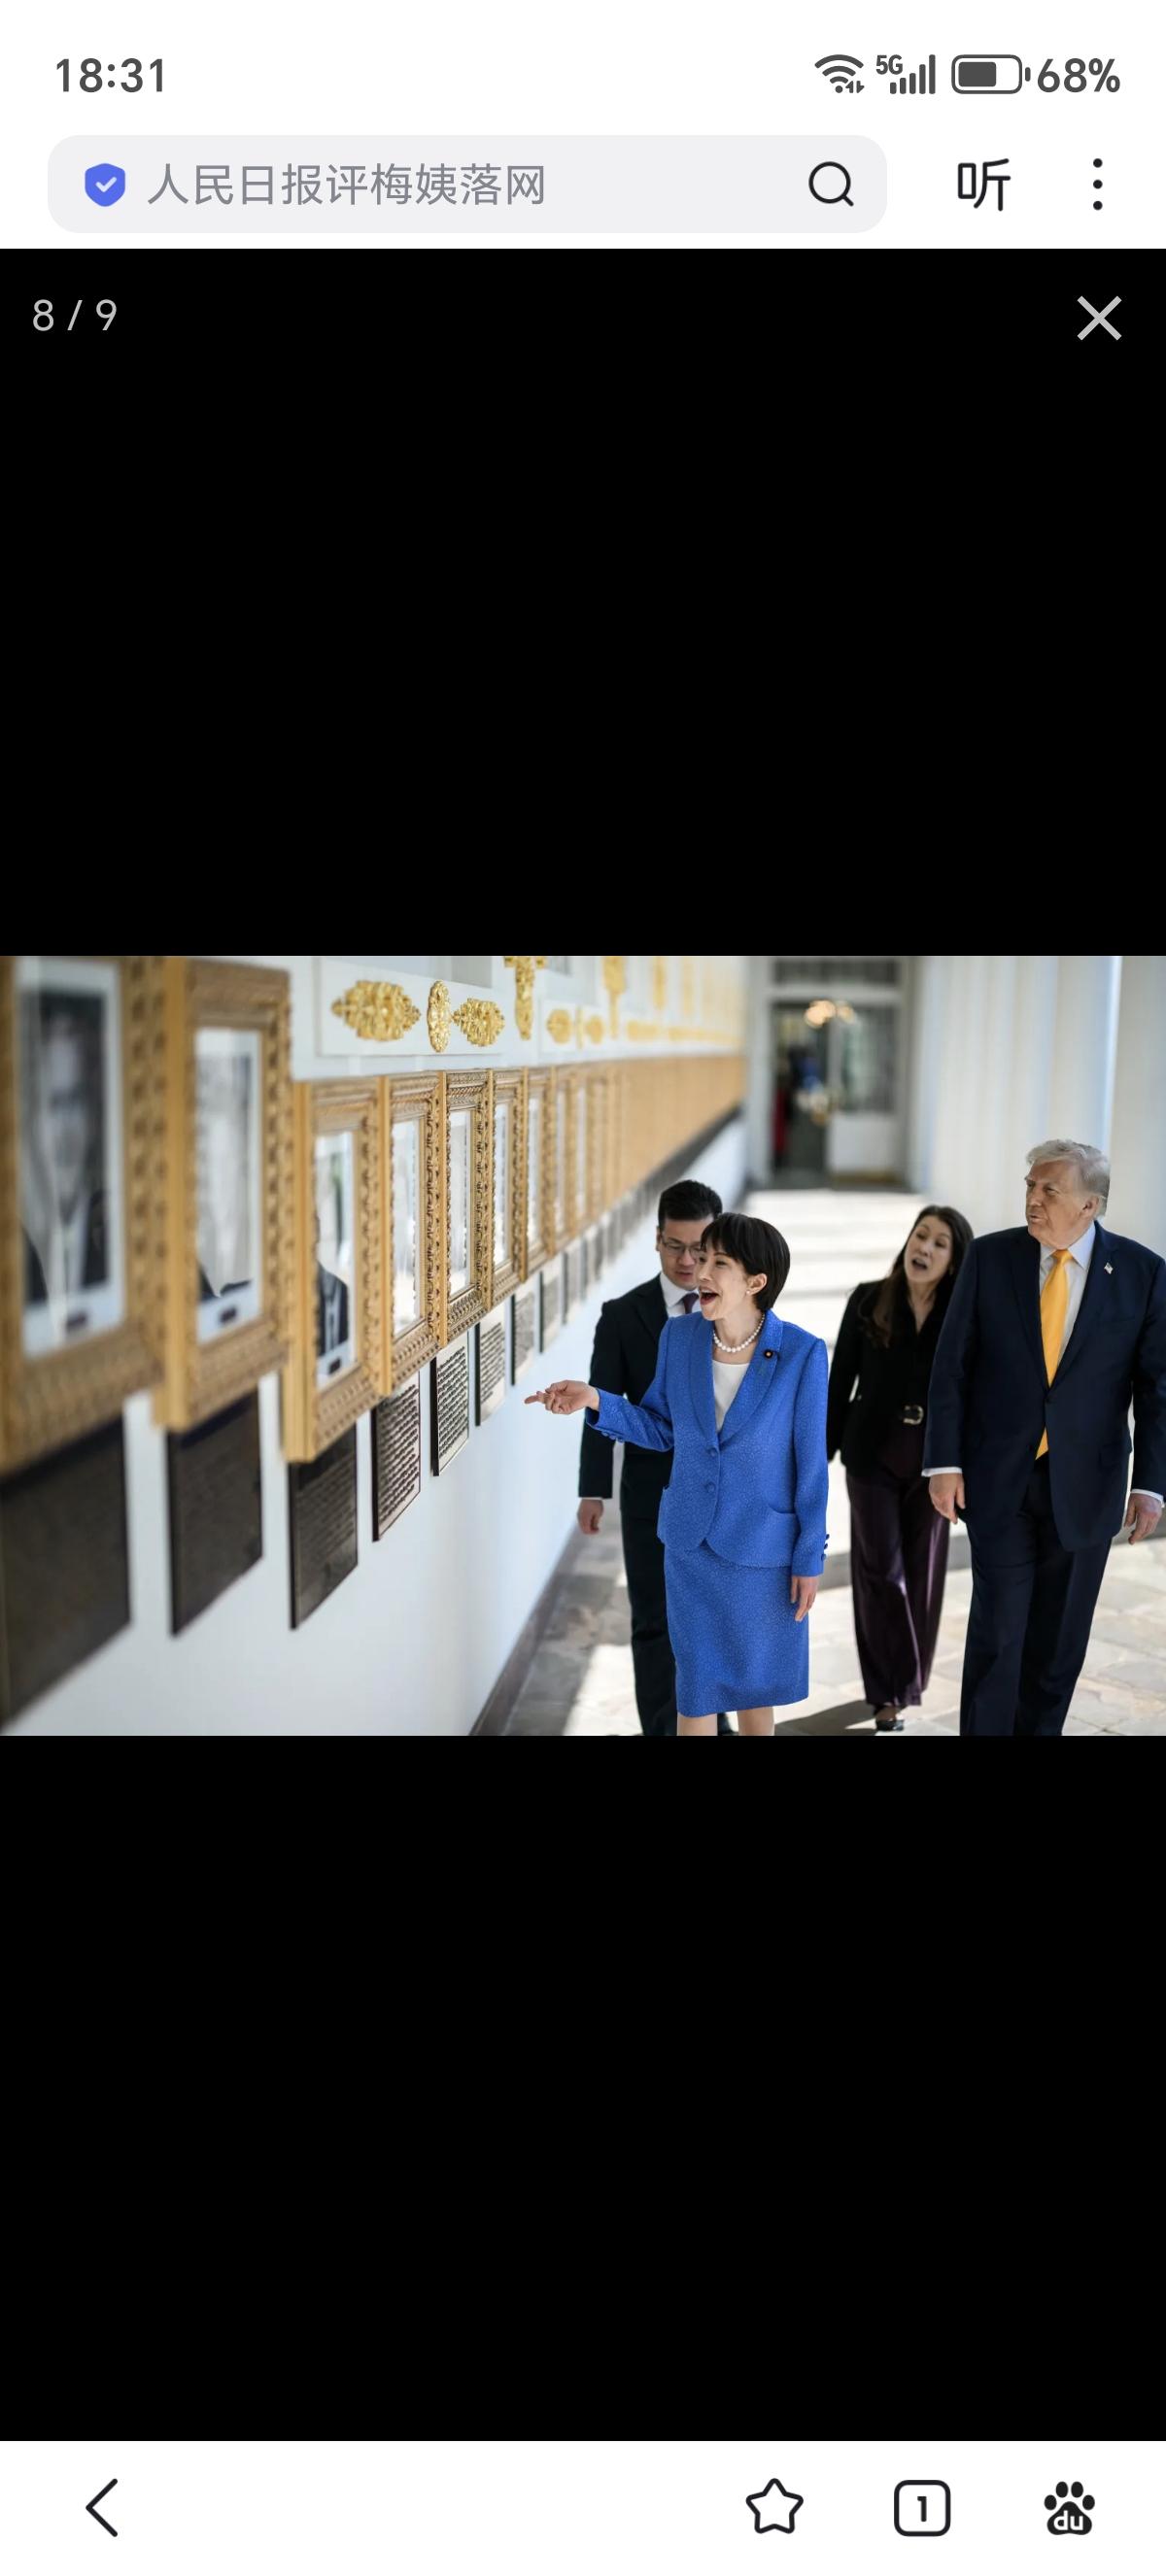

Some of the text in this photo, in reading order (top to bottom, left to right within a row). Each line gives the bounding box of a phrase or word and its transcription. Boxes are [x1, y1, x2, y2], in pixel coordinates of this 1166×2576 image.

[56, 58, 162, 92] 18:31
[875, 54, 904, 76] 5G
[1038, 58, 1120, 92] 68%
[148, 163, 544, 205] 人民日报评梅姨落网
[957, 158, 1012, 212] 听
[917, 2496, 927, 2522] 1
[1053, 2509, 1084, 2531] du
